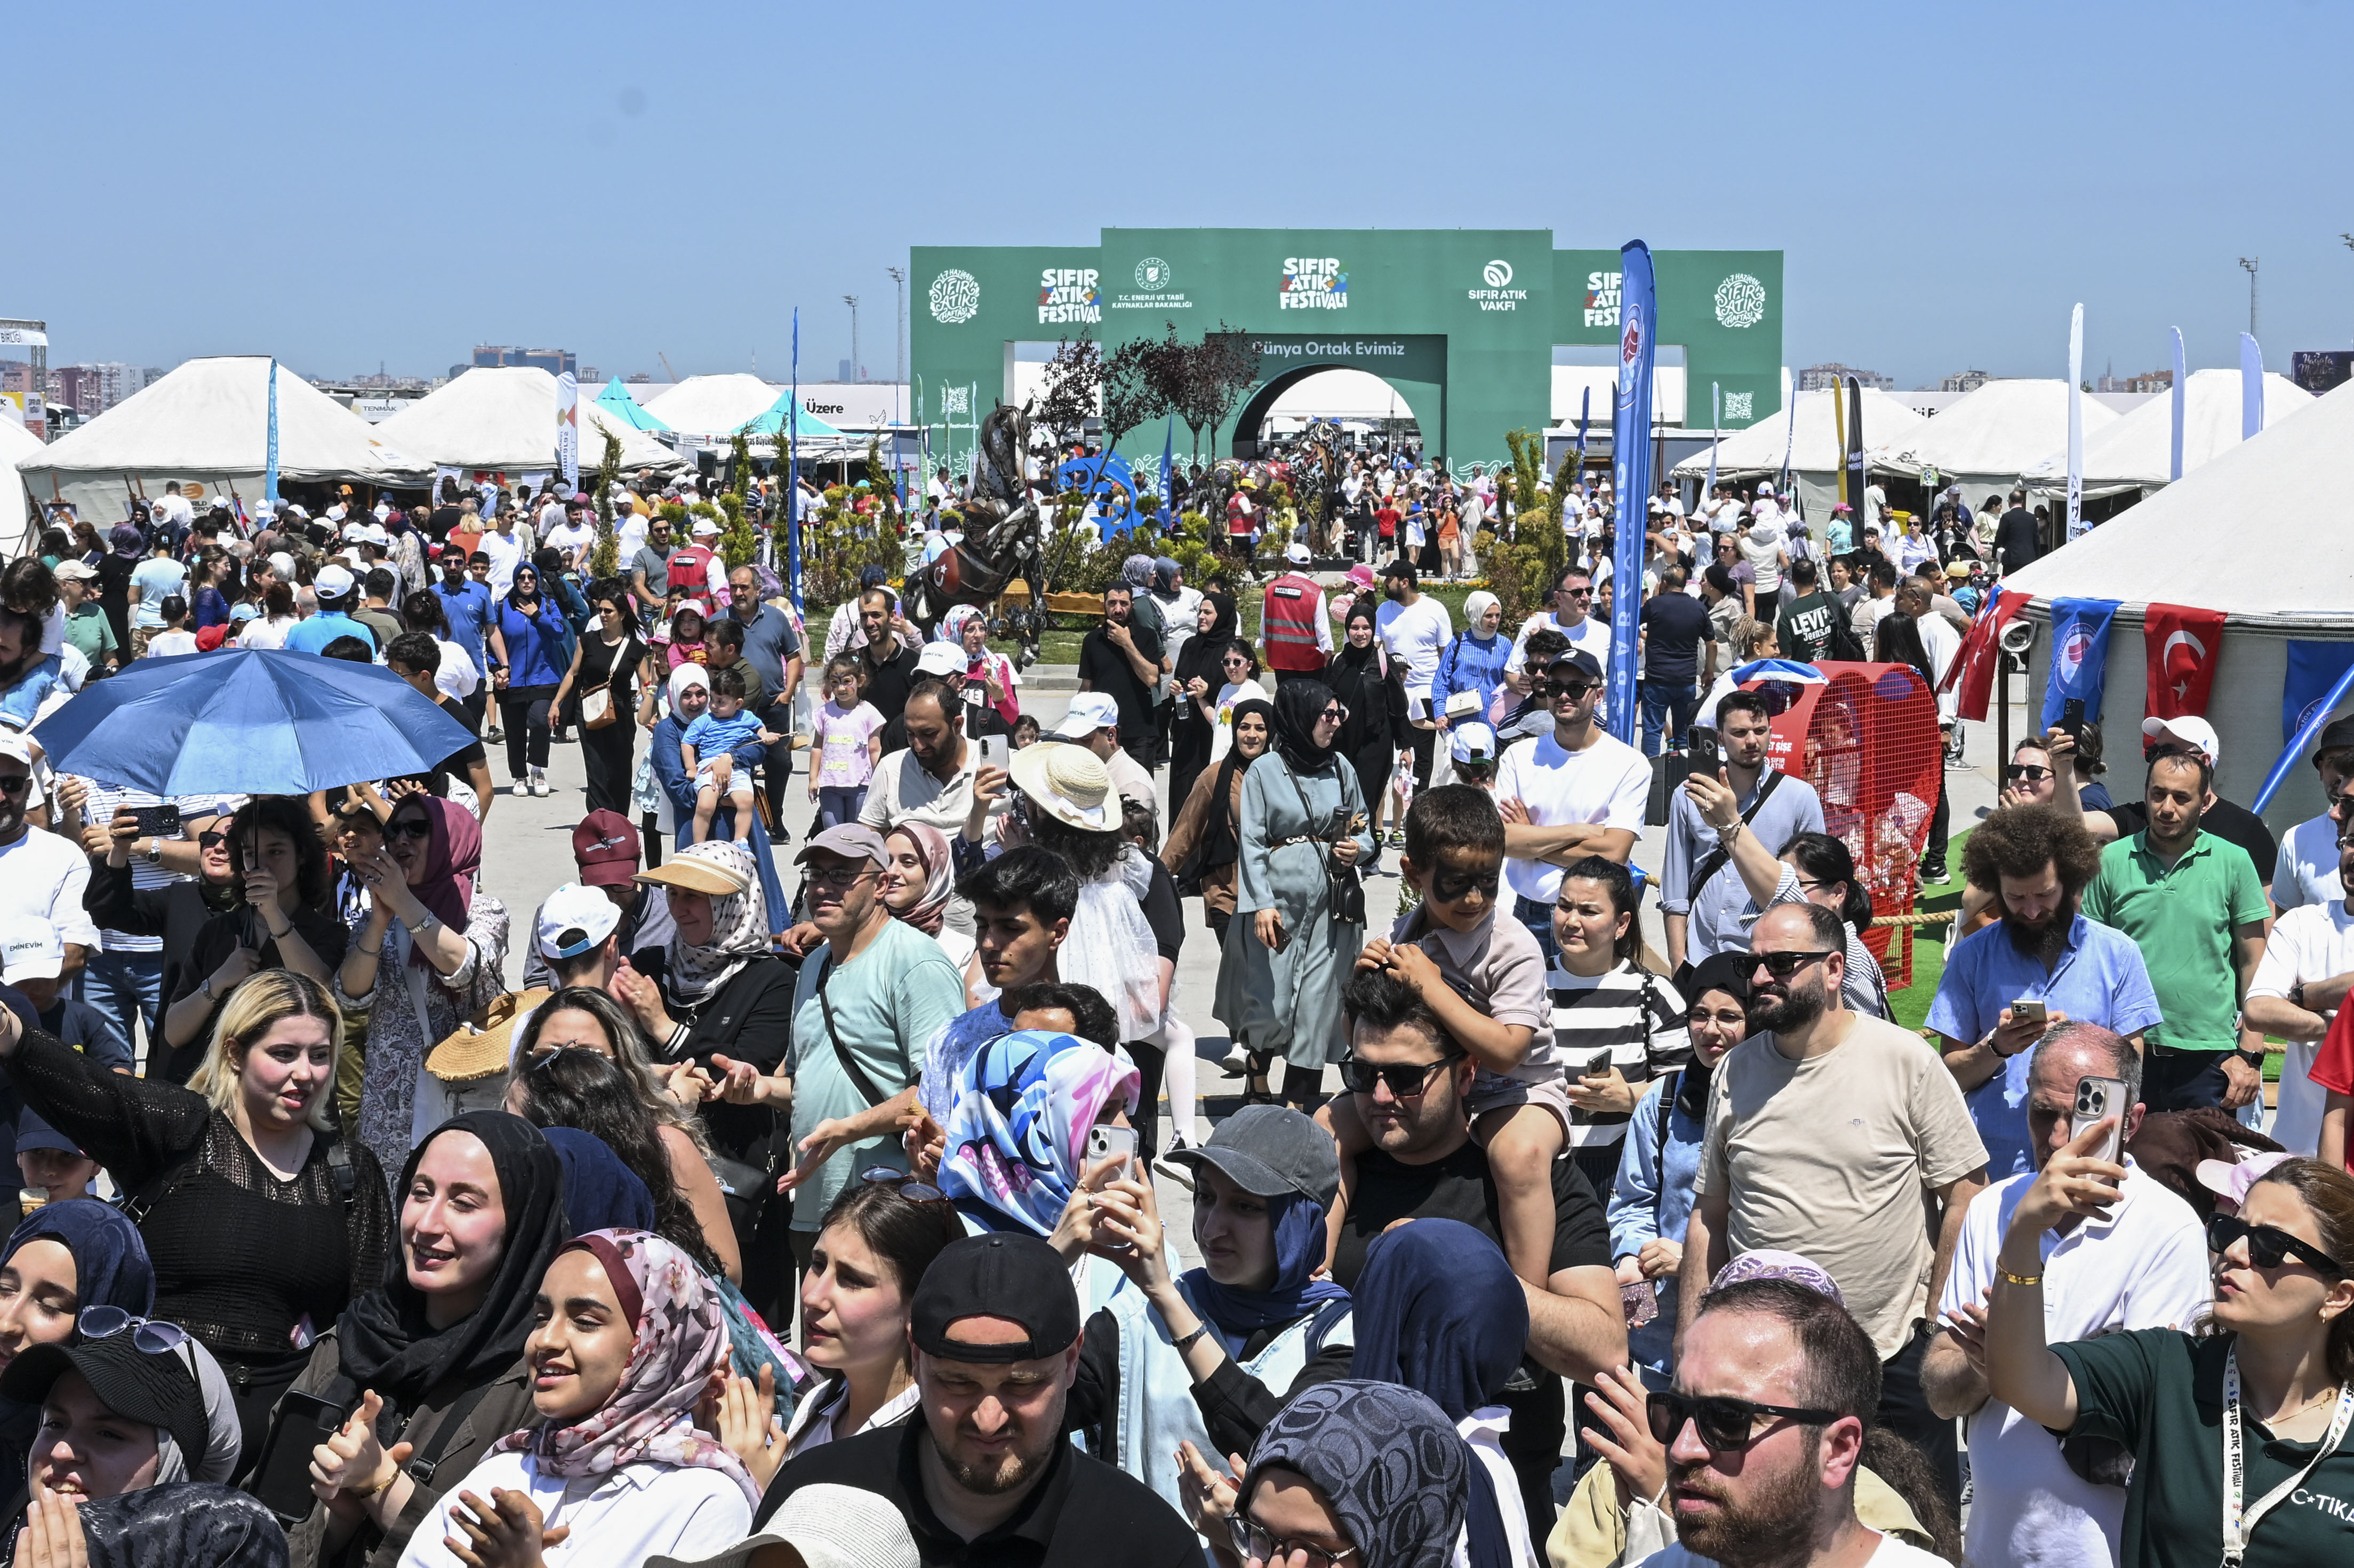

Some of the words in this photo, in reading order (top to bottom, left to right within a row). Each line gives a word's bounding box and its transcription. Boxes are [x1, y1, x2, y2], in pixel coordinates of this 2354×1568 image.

[1283, 257, 1340, 276] SIFIR
[1041, 269, 1099, 288] SIFIR
[1287, 274, 1331, 292] ATIK
[931, 275, 975, 303] SIFIR
[1046, 286, 1091, 306] ATIK
[1468, 290, 1499, 299] SIFIR
[1500, 290, 1527, 299] ATIK
[1717, 279, 1761, 308] SIFIR
[935, 293, 977, 311] ATIK
[1479, 301, 1515, 310] VAKFI
[1721, 298, 1763, 316] ATIK
[1306, 341, 1351, 355] Ortak
[1356, 341, 1404, 355] Evimiz
[806, 398, 844, 414] Üzere
[1775, 740, 1792, 754] ŞİŞE
[10, 941, 43, 952] EMİNEVİM
[2228, 1398, 2238, 1420] SIFIR
[2230, 1429, 2240, 1450] ATIK
